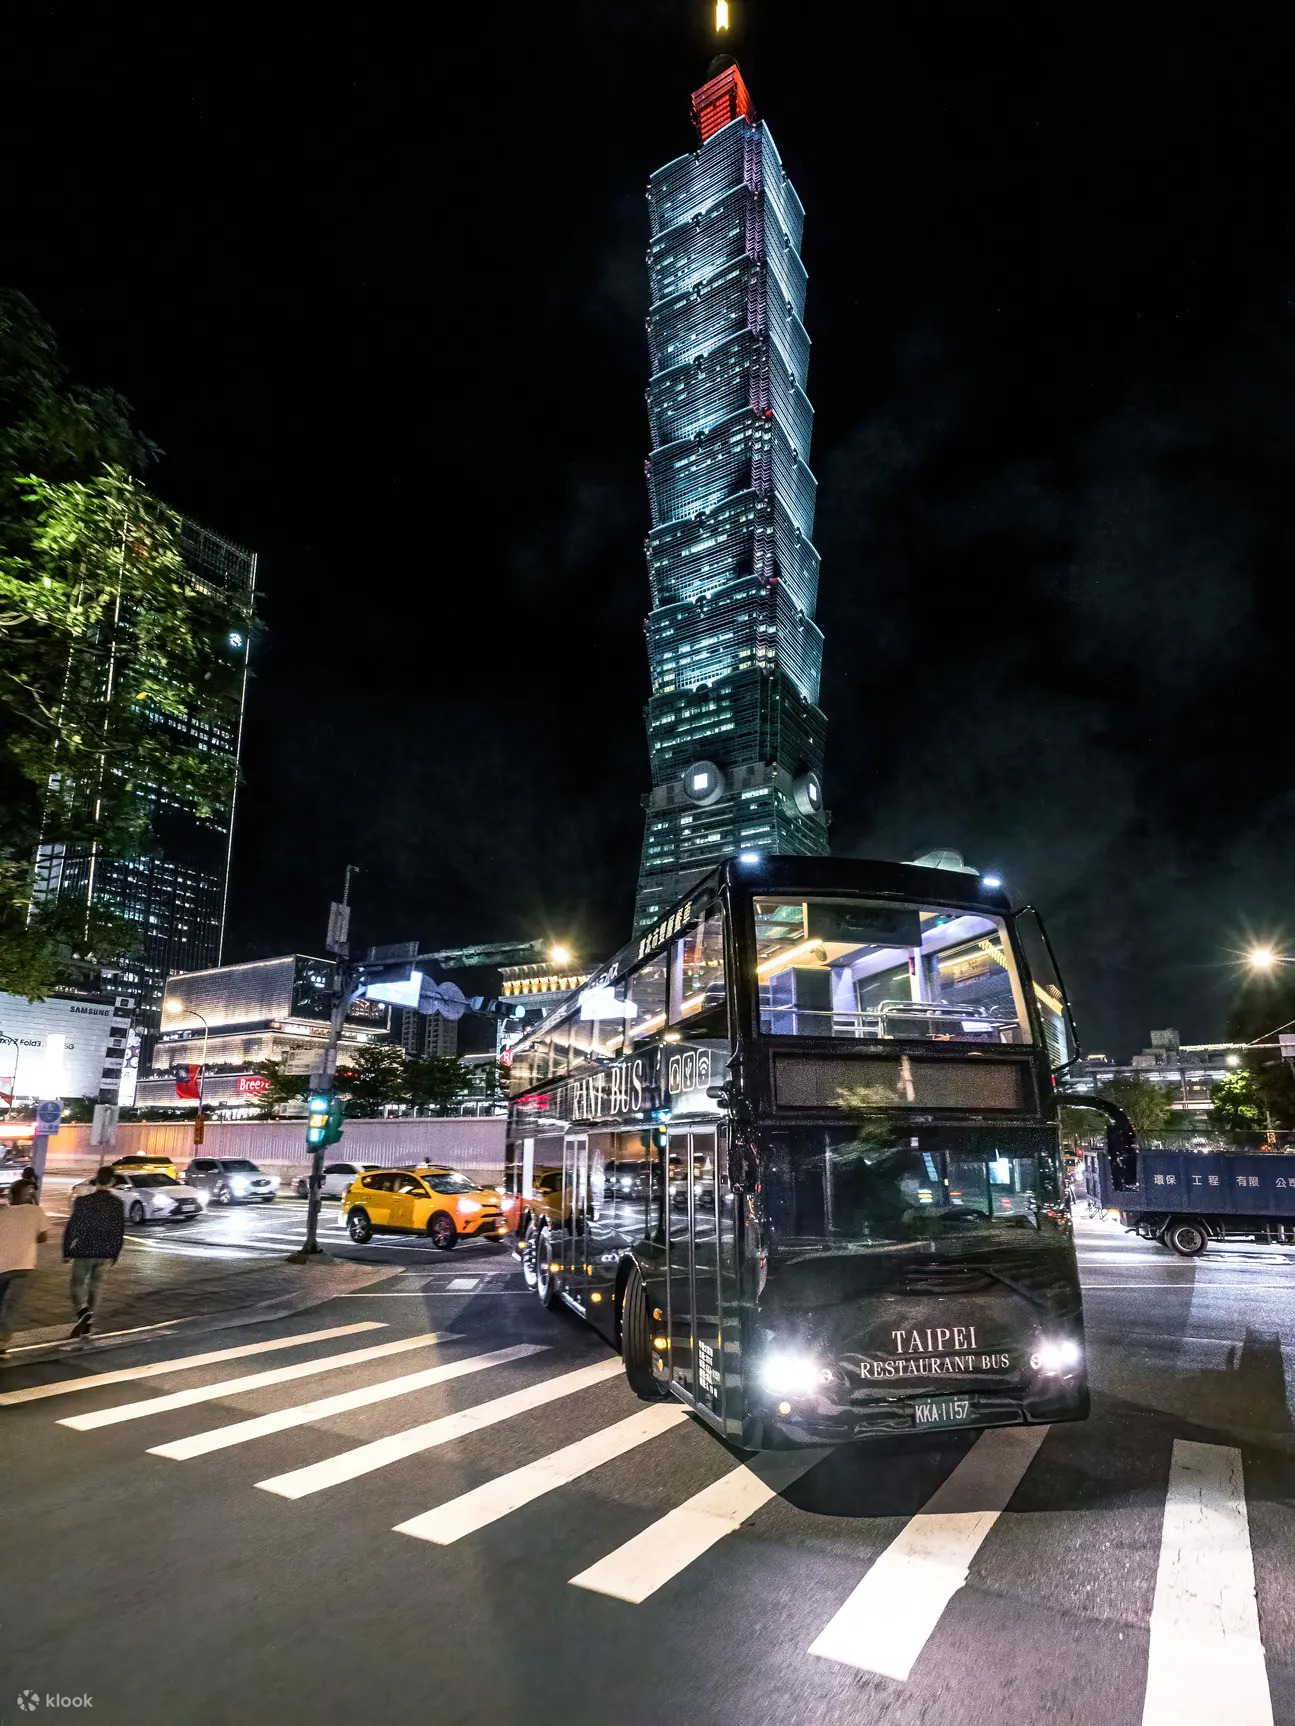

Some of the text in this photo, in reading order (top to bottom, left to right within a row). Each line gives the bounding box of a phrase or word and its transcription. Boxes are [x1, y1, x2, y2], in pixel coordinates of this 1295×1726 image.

[70, 1006, 109, 1017] SAMSUNG
[20, 1039, 42, 1047] Fold3
[610, 1060, 642, 1115] BUS
[892, 1326, 977, 1354] TAIPEI
[860, 1353, 1010, 1379] RESTAURANT BUS
